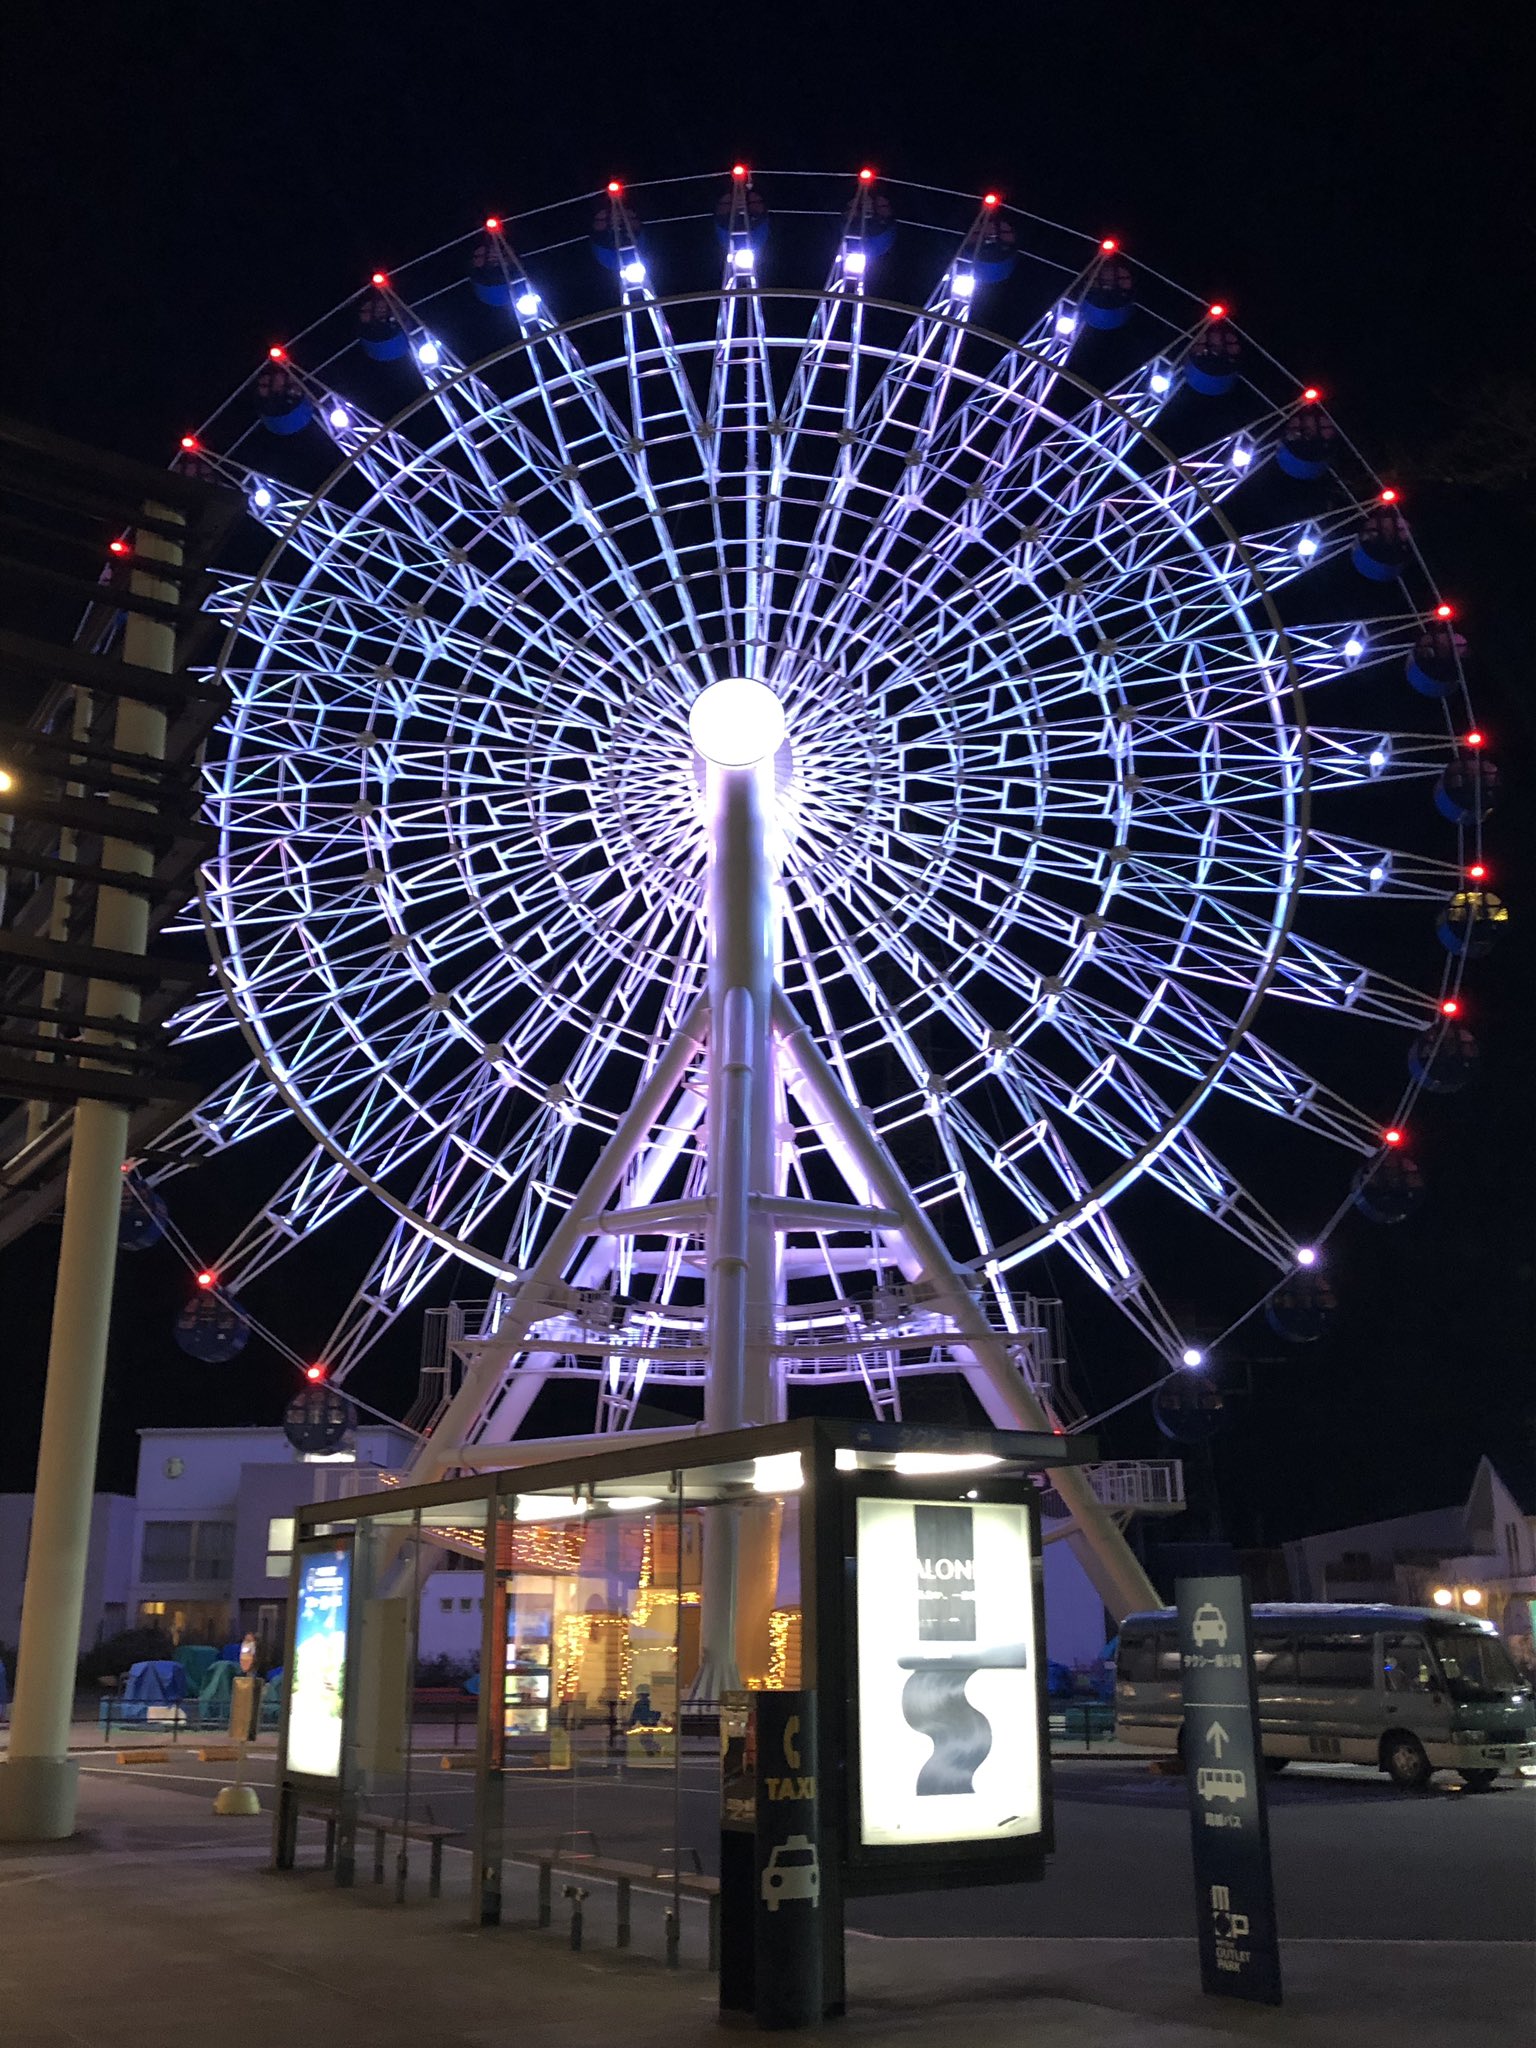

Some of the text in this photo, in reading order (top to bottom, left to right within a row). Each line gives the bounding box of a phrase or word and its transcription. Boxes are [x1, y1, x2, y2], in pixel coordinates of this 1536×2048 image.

[764, 1777, 817, 1801] TAXI
[1216, 1948, 1251, 1963] OUTLET
[1217, 1959, 1241, 1973] PARK
